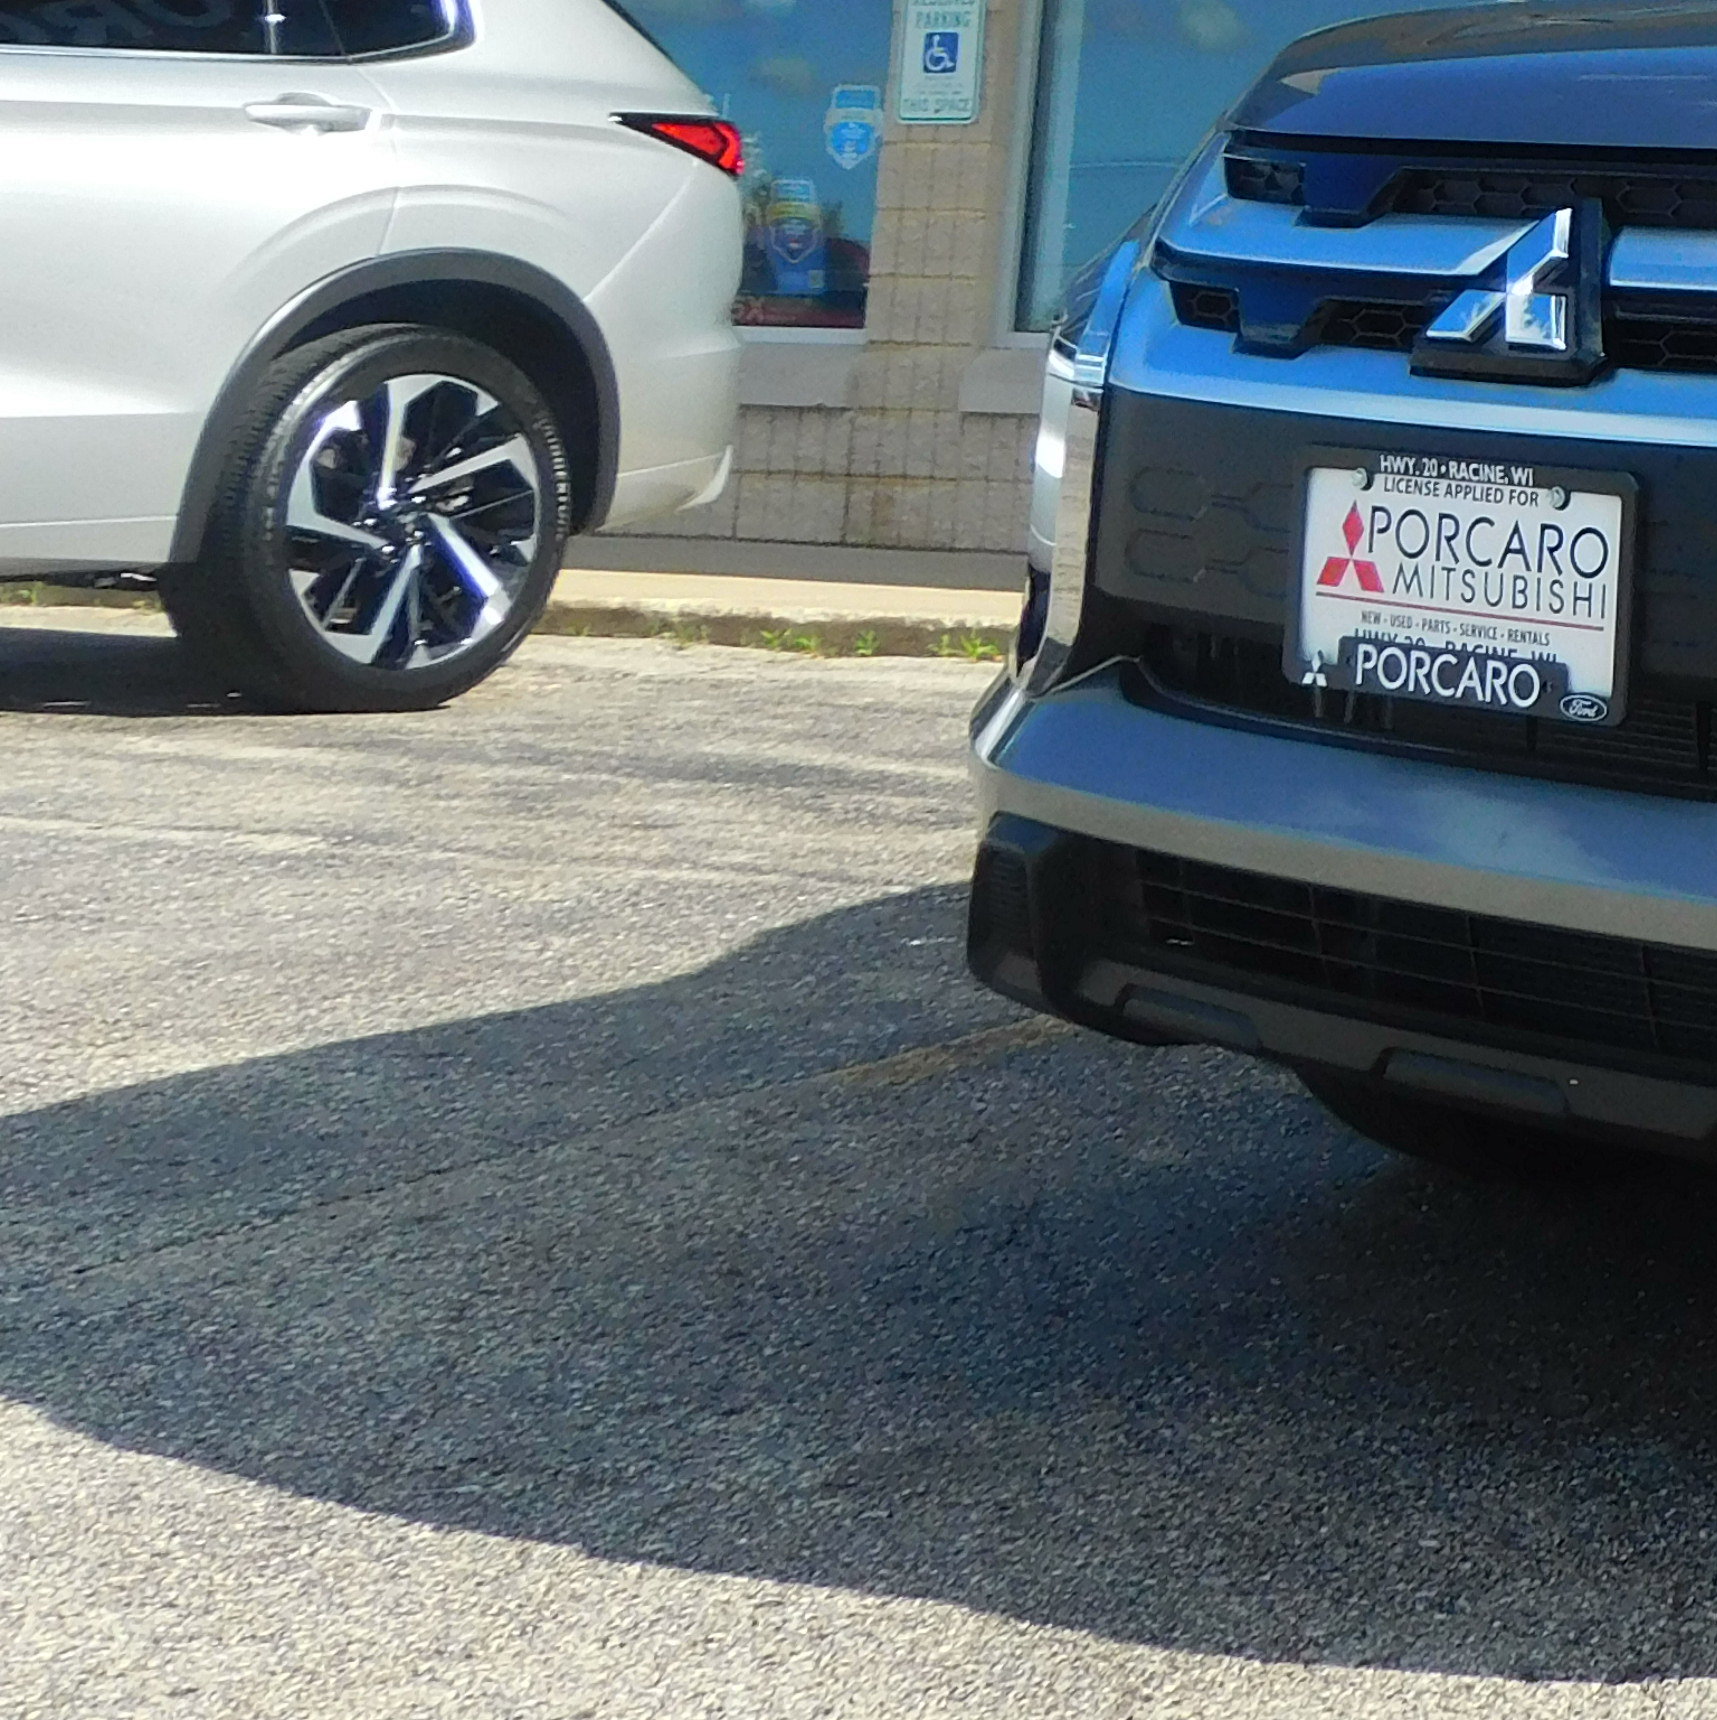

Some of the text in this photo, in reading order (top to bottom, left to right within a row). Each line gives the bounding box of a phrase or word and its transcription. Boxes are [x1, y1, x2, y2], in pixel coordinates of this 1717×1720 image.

[1380, 454, 1534, 486] HWY. 20 RACINE, WI
[1384, 476, 1539, 507] LICENSE APPLIED FOR
[1367, 505, 1609, 579] PORCARO
[1392, 561, 1607, 619] MITSUBISHI
[1361, 610, 1381, 625] NEW
[1390, 615, 1413, 629] USED
[1421, 618, 1451, 635] PARTS
[1459, 622, 1498, 641] SERVICE
[1507, 628, 1551, 647] RENTALS
[1355, 643, 1541, 708] PORCARO
[1566, 697, 1601, 718] Ford
